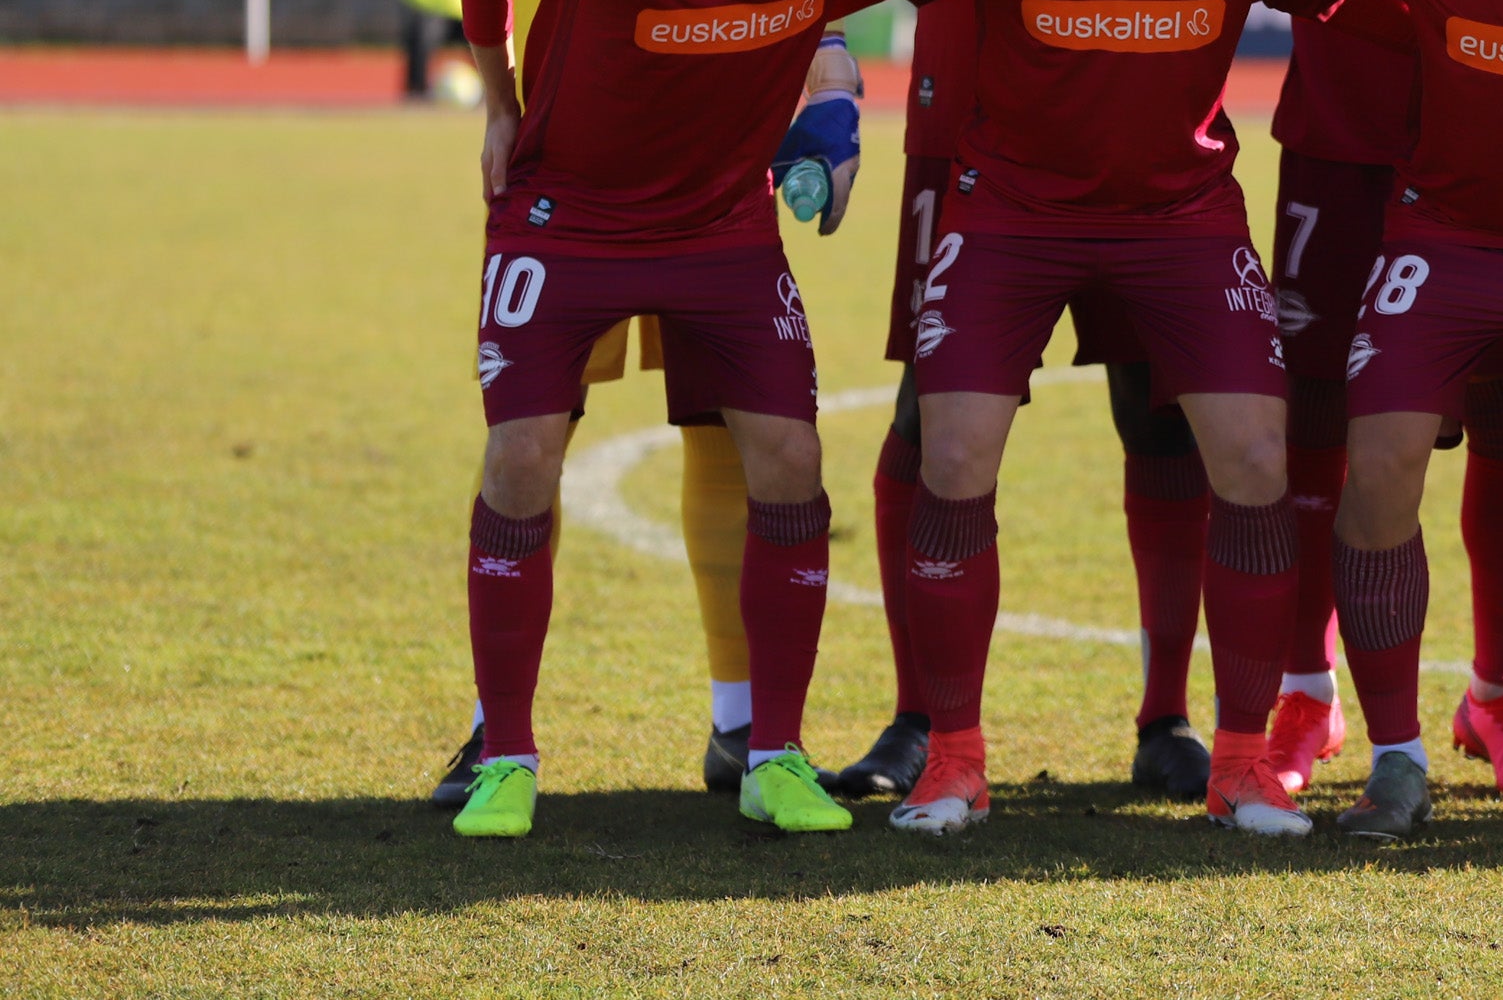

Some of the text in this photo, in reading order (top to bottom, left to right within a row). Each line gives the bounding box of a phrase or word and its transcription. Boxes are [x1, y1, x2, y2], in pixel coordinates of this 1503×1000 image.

[652, 6, 794, 43] euskaltel
[1036, 11, 1181, 40] euskaltel
[1286, 200, 1319, 279] 7
[480, 253, 547, 330] 10
